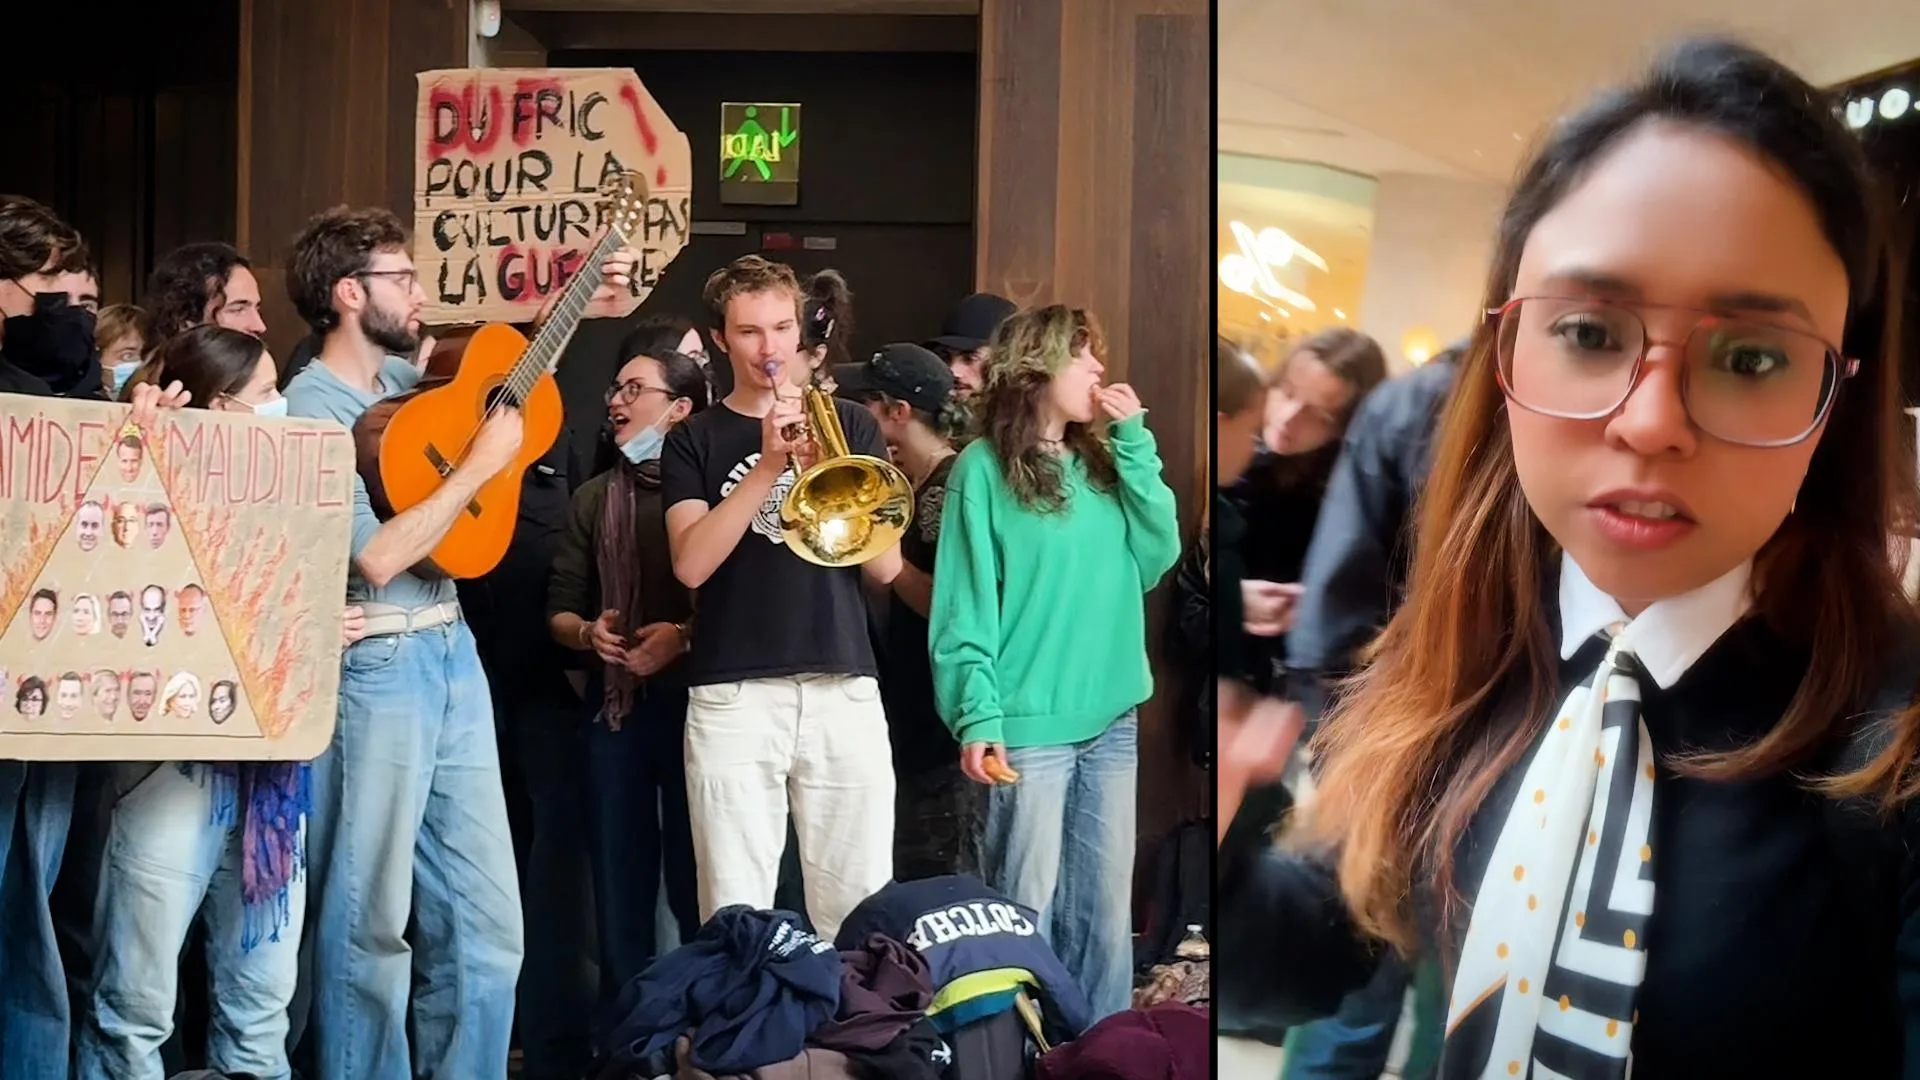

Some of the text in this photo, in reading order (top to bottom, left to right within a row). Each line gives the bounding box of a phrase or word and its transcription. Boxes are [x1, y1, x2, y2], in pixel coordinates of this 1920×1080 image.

[432, 87, 497, 151] DU
[511, 87, 610, 143] FRIC
[425, 150, 624, 205] POUR LA
[643, 197, 689, 246] PAS
[438, 254, 487, 305] LA
[906, 902, 1036, 952] GOTCHA
